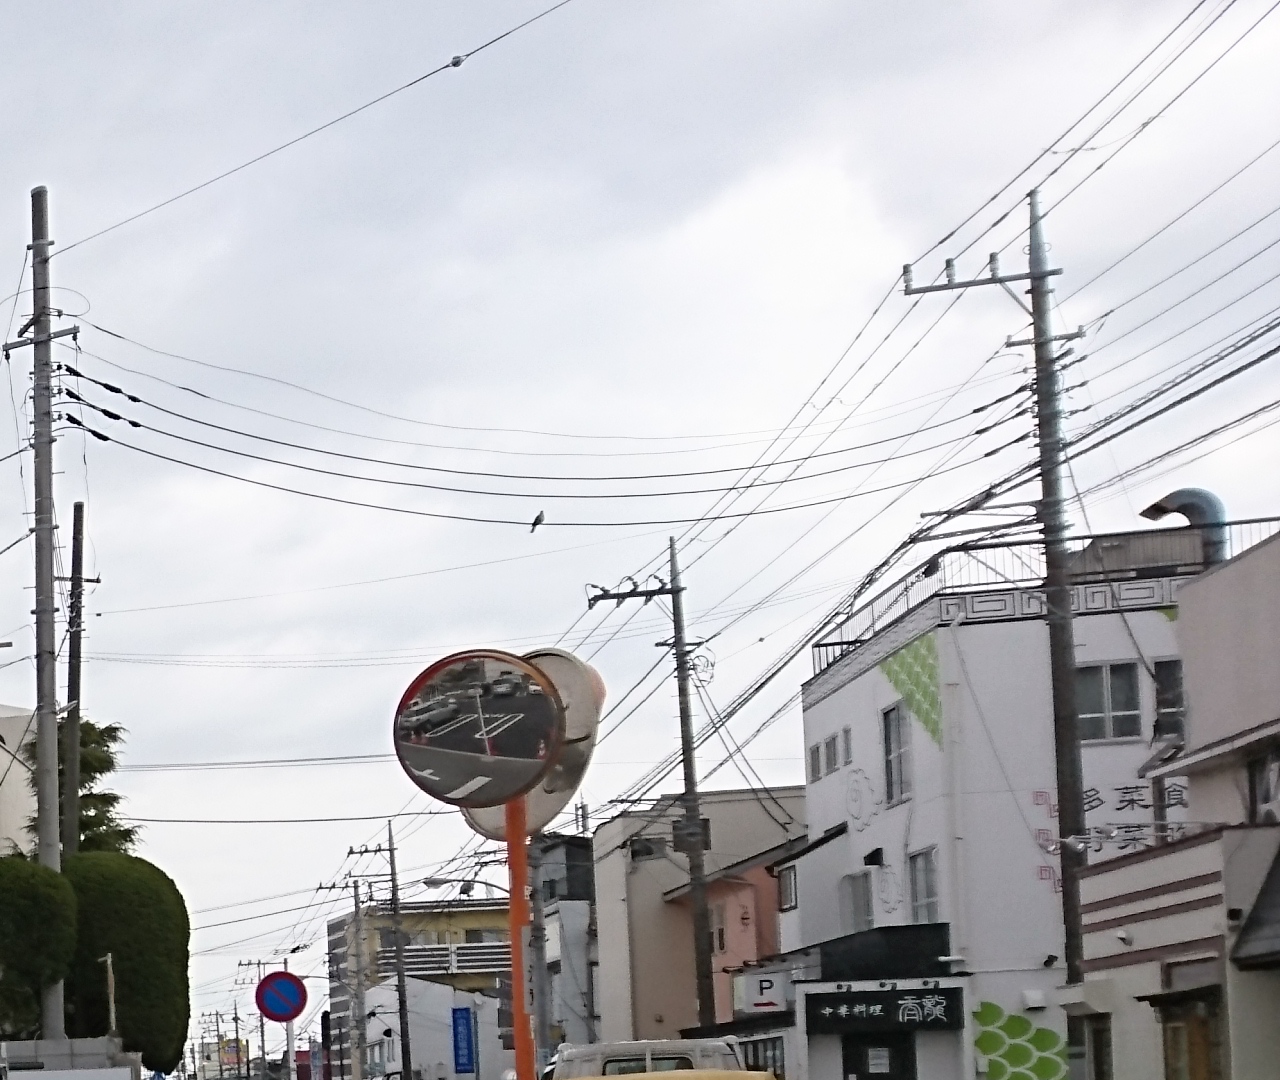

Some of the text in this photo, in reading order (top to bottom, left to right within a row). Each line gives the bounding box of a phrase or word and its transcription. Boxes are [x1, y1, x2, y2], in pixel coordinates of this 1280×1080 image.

[758, 979, 775, 996] P
[821, 1003, 885, 1018] 中華料理
